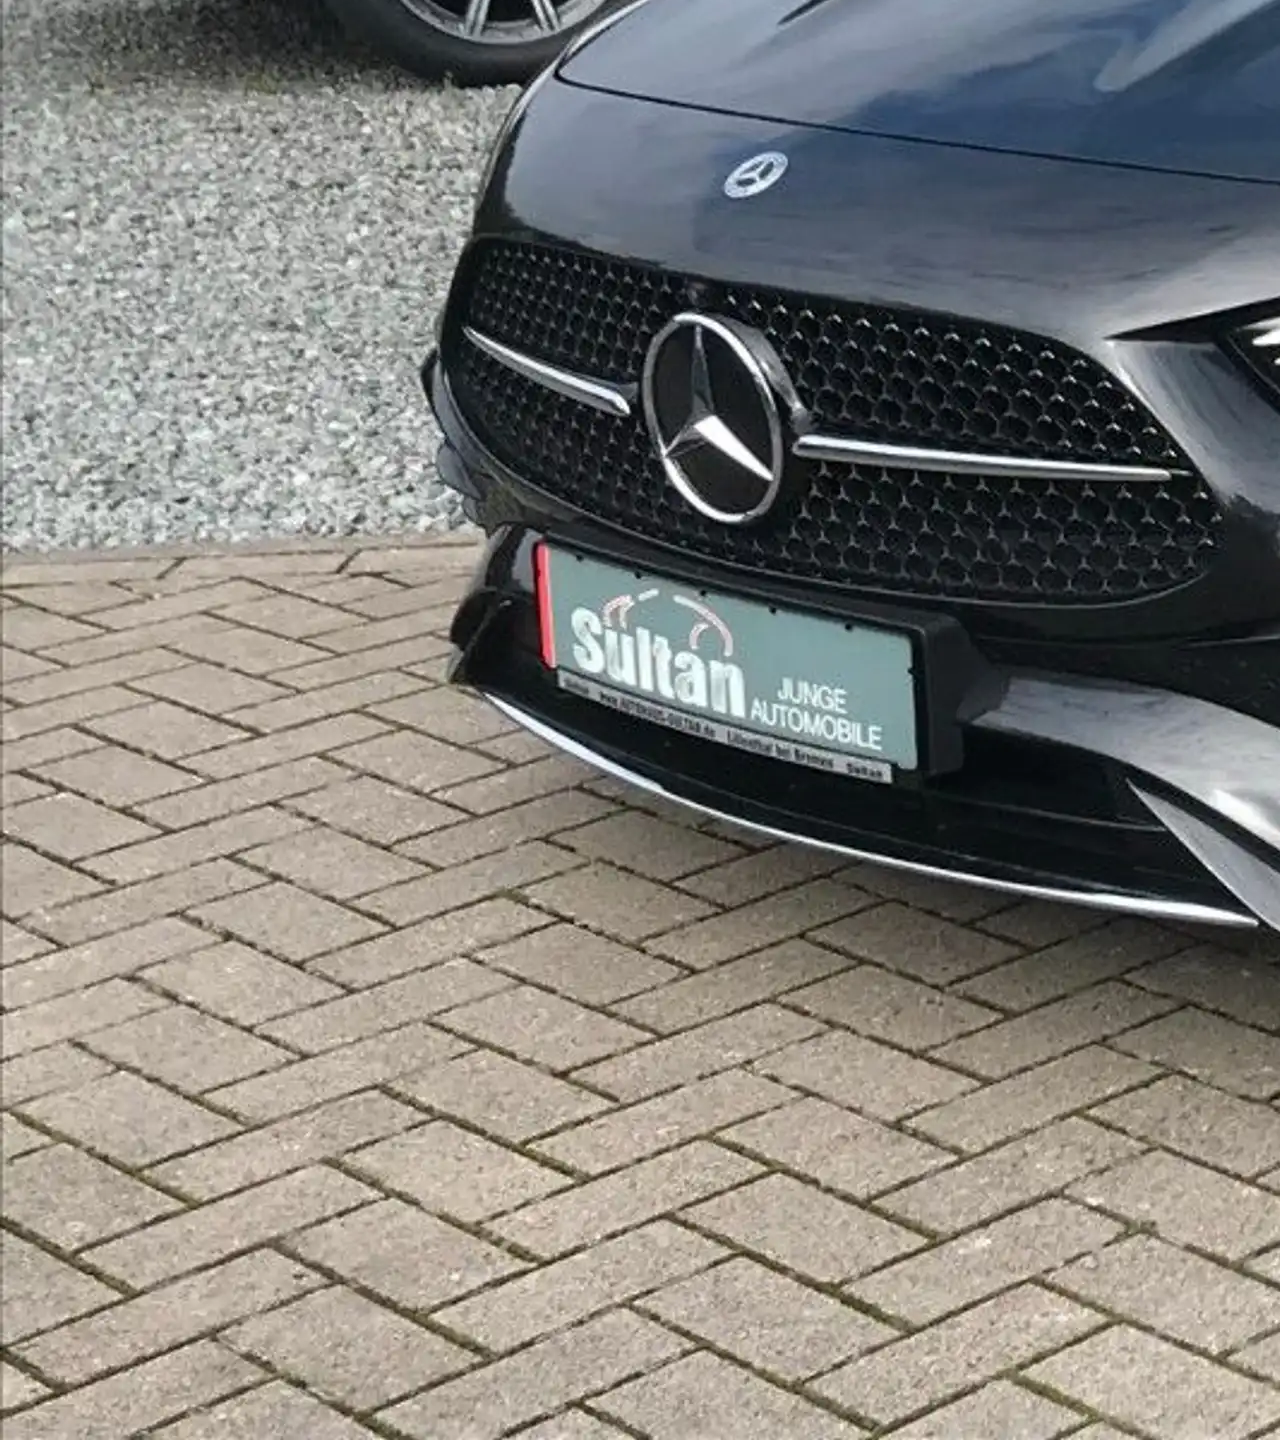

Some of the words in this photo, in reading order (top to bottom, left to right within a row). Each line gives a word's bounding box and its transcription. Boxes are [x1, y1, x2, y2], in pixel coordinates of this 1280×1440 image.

[571, 607, 746, 718] Sultan
[777, 677, 848, 714] JUNGE
[751, 697, 882, 750] AUTOMOBILE
